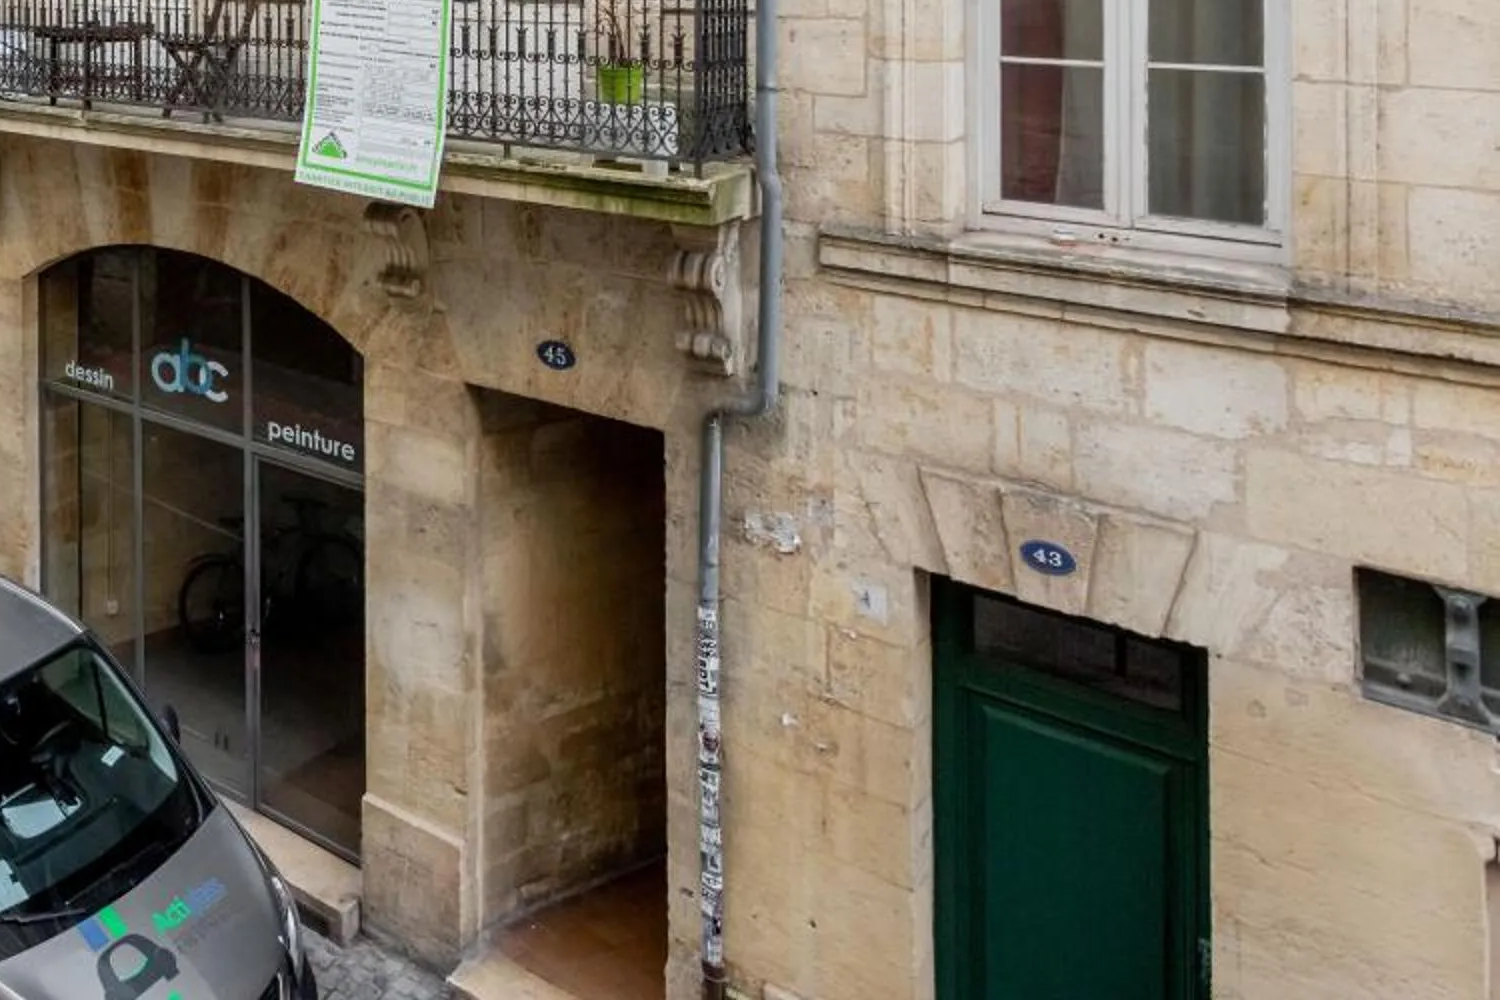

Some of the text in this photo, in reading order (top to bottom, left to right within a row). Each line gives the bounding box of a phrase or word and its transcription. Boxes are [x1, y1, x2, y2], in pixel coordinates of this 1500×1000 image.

[151, 337, 229, 403] abc
[543, 345, 567, 366] 45
[65, 359, 114, 392] dessin
[267, 420, 356, 461] peinture
[1033, 548, 1063, 568] 43
